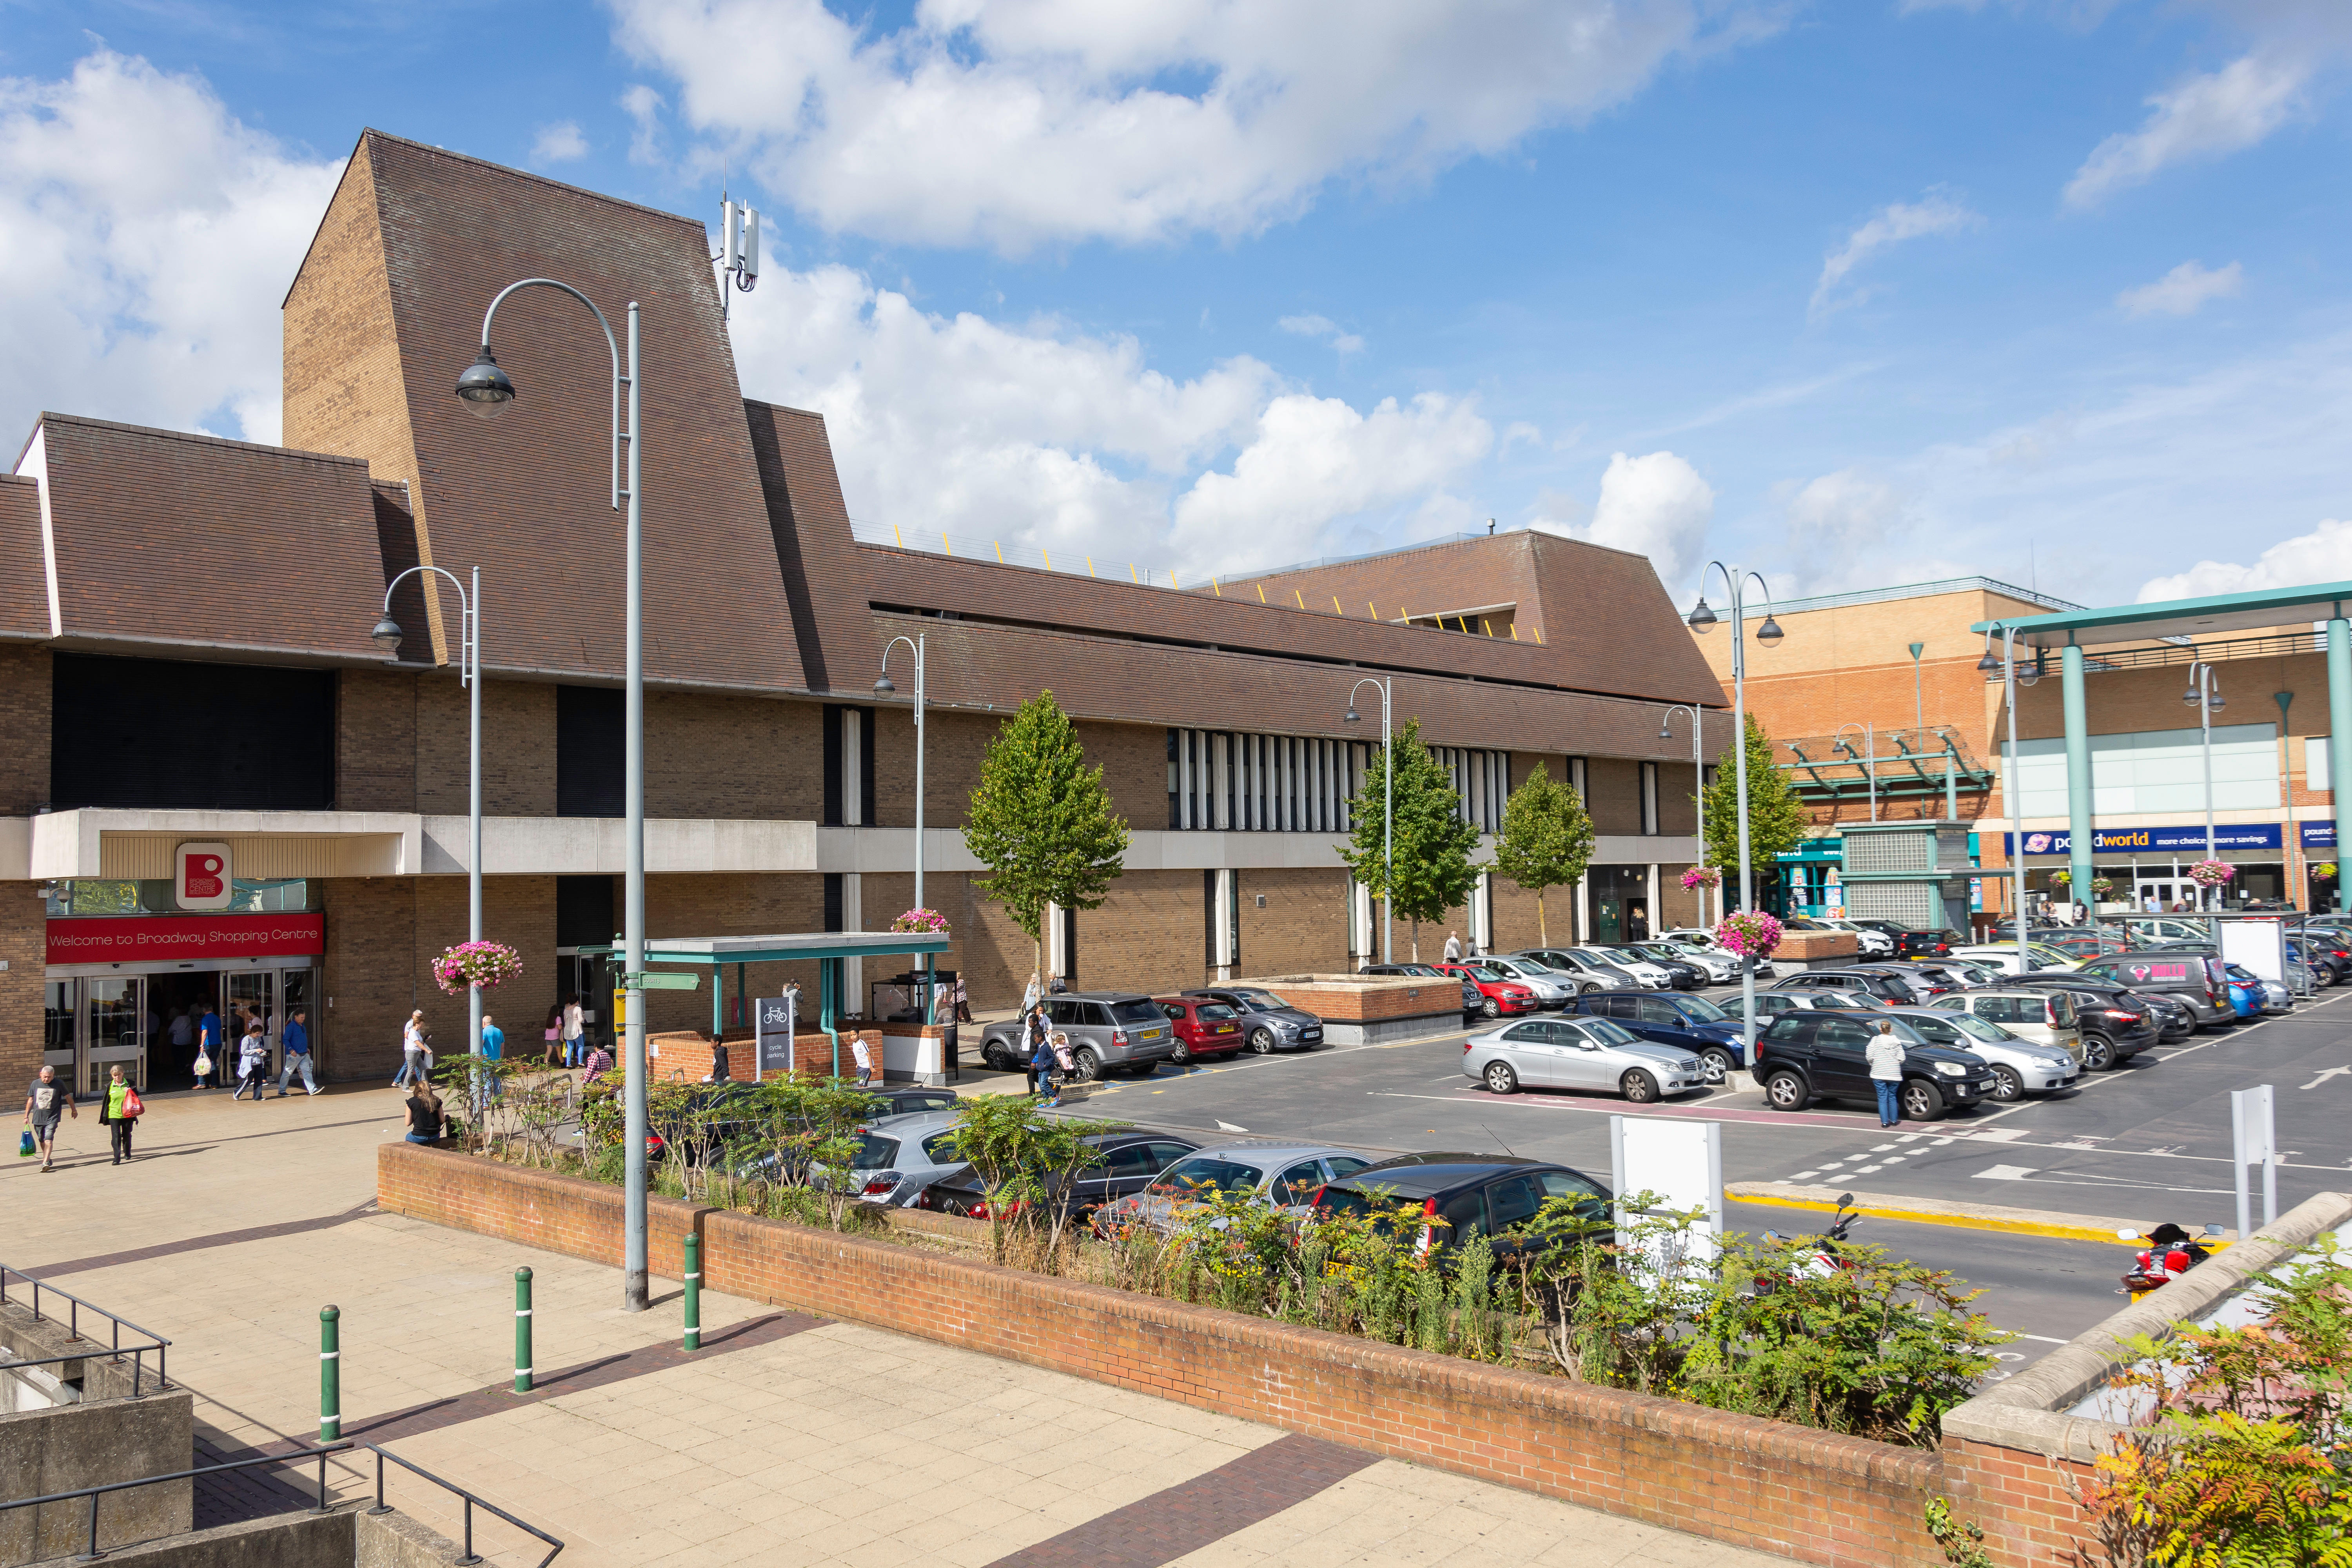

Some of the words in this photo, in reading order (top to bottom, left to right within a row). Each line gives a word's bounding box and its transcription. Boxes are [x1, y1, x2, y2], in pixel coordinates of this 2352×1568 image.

[2055, 832, 2149, 851] podworld
[49, 935, 113, 946] Welcome
[117, 935, 133, 944] to
[137, 932, 205, 945] Broadway
[210, 931, 268, 944] Shopping
[272, 929, 318, 939] Centre
